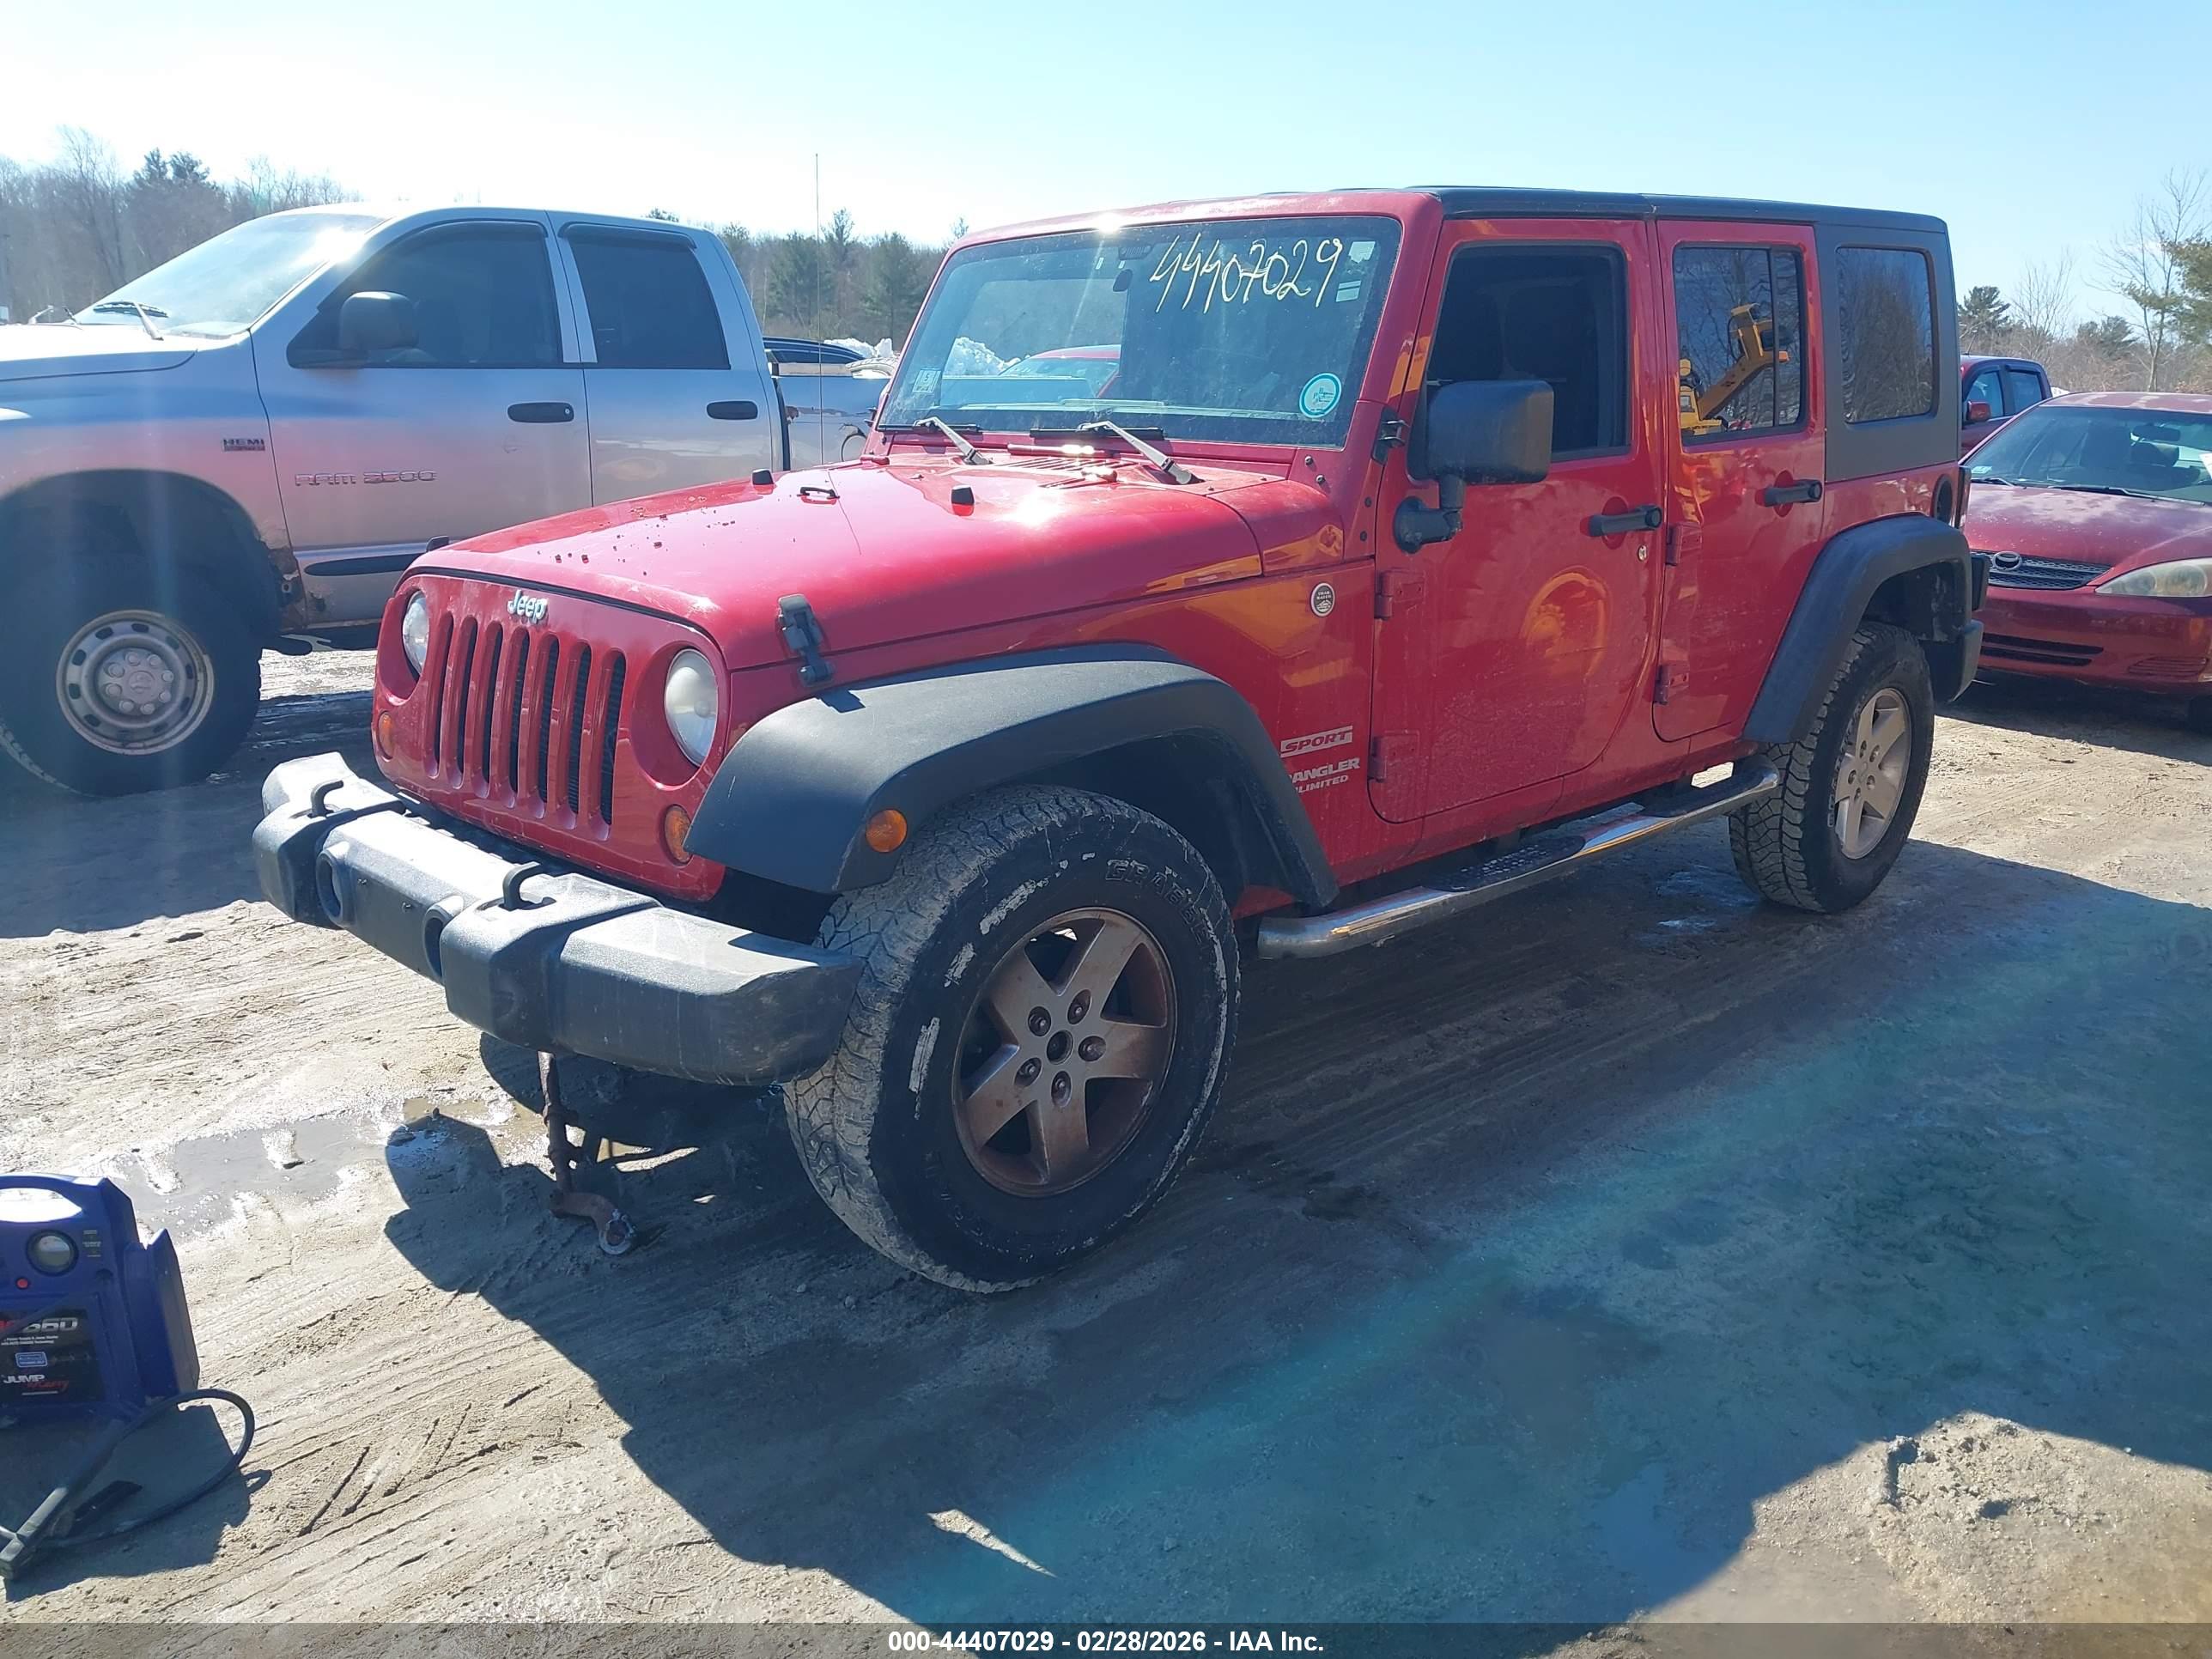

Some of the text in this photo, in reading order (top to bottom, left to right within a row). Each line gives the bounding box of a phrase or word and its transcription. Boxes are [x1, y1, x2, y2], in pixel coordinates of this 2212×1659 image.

[1149, 233, 1344, 314] 44407029
[295, 472, 357, 487] RAM
[507, 589, 549, 624] Jeep
[1280, 727, 1352, 755] SPORT
[1289, 757, 1361, 783] ANGLER
[1296, 775, 1349, 793] LIMITED
[3, 1374, 46, 1384] JUMP
